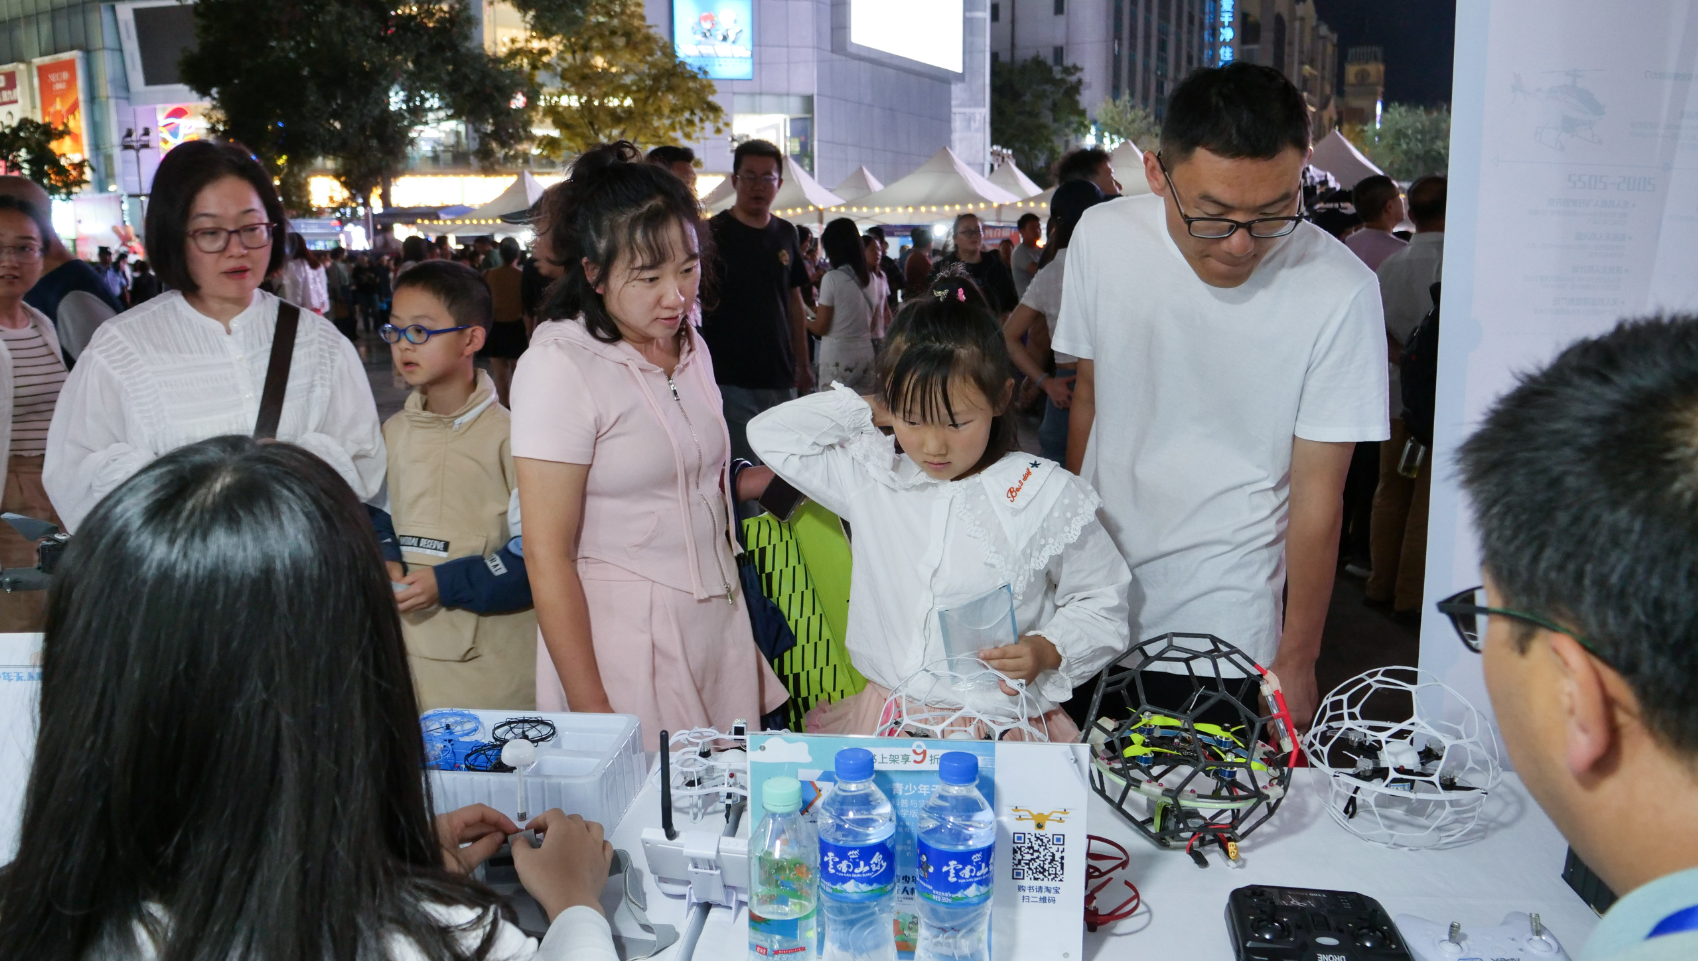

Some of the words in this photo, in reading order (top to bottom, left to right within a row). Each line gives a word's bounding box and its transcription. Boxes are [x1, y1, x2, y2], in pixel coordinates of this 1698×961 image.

[1017, 885, 1061, 895] 购书请淘宝
[1021, 895, 1056, 904] 扫二维码
